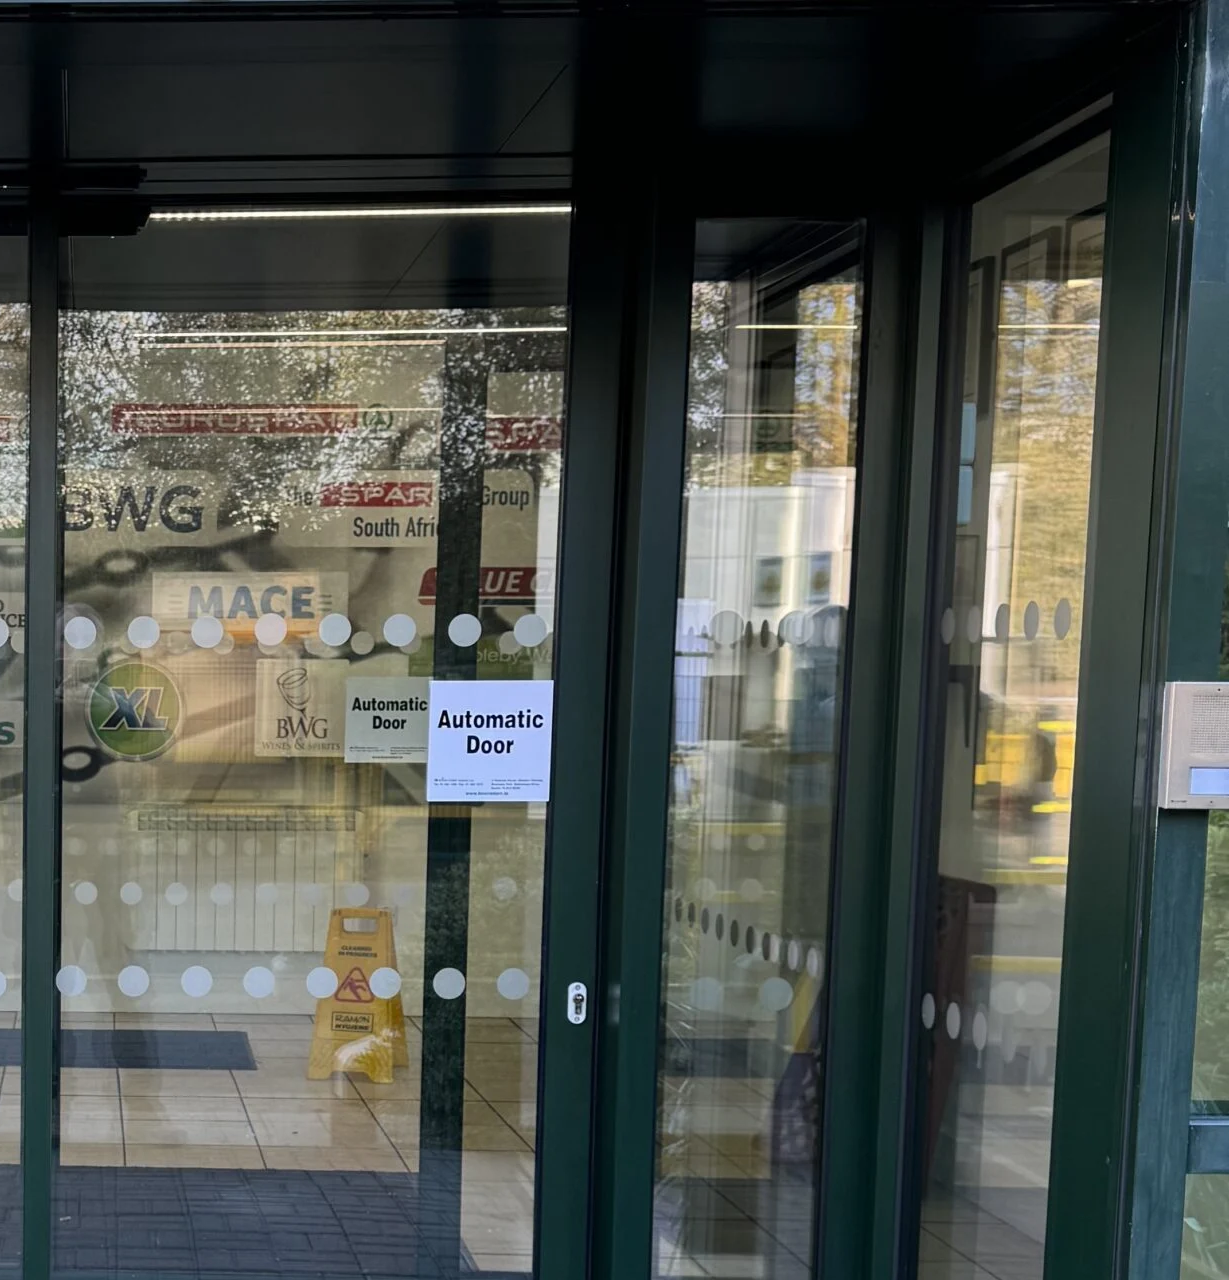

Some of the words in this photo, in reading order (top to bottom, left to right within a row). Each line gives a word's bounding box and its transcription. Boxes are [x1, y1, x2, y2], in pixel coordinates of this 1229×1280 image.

[485, 421, 562, 443] SPA
[340, 486, 431, 503] SPAR
[481, 486, 530, 510] Group
[64, 485, 205, 533] BWG
[353, 516, 400, 537] South
[405, 516, 440, 537] Afri
[187, 585, 316, 619] MACE
[99, 687, 169, 730] XL
[352, 697, 428, 711] Automatic
[276, 716, 329, 739] BWG
[372, 715, 408, 730] Door
[437, 709, 545, 729] Automatic
[261, 741, 292, 751] WINES
[294, 739, 305, 751] &
[466, 735, 515, 754] Door
